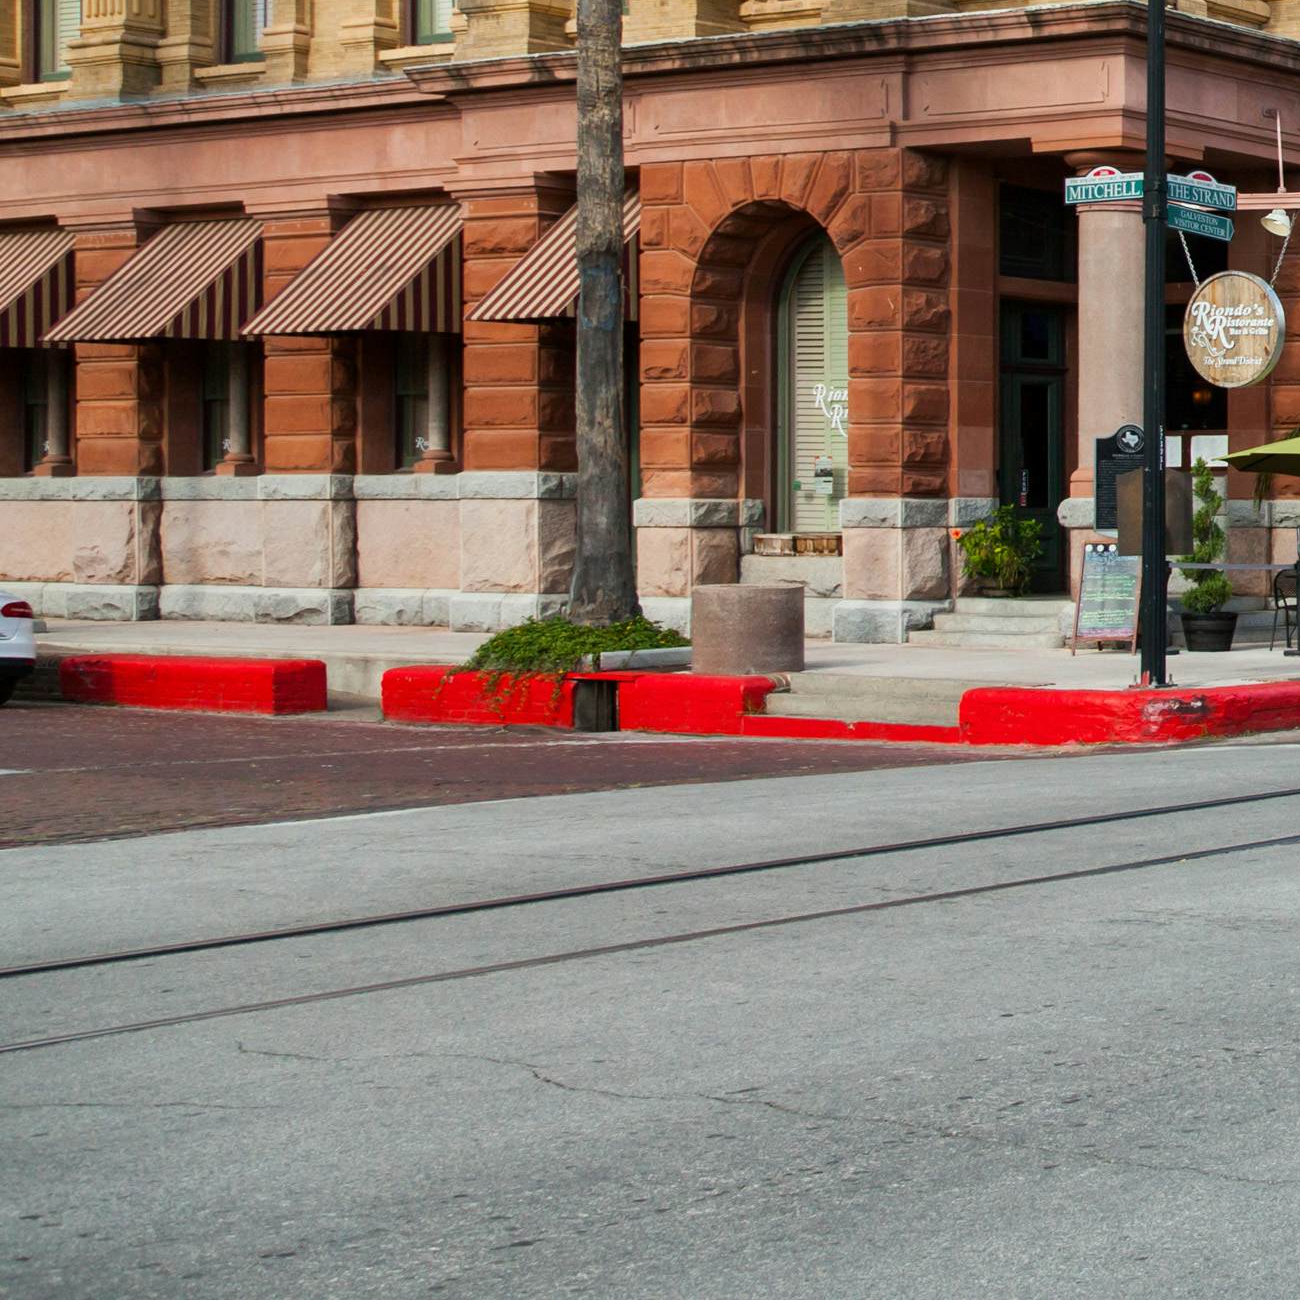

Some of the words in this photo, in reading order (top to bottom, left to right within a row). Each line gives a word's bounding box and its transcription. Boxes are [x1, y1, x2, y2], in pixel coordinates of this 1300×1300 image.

[1069, 181, 1142, 201] MITCHELL
[1168, 183, 1191, 200] THE
[1192, 187, 1234, 208] STRAND
[1173, 217, 1200, 230] VISITOR
[1200, 223, 1226, 238] CENTER
[1180, 210, 1219, 226] GALVESTON
[1191, 301, 1264, 335] Riondo's
[1208, 316, 1274, 349] Ristorante
